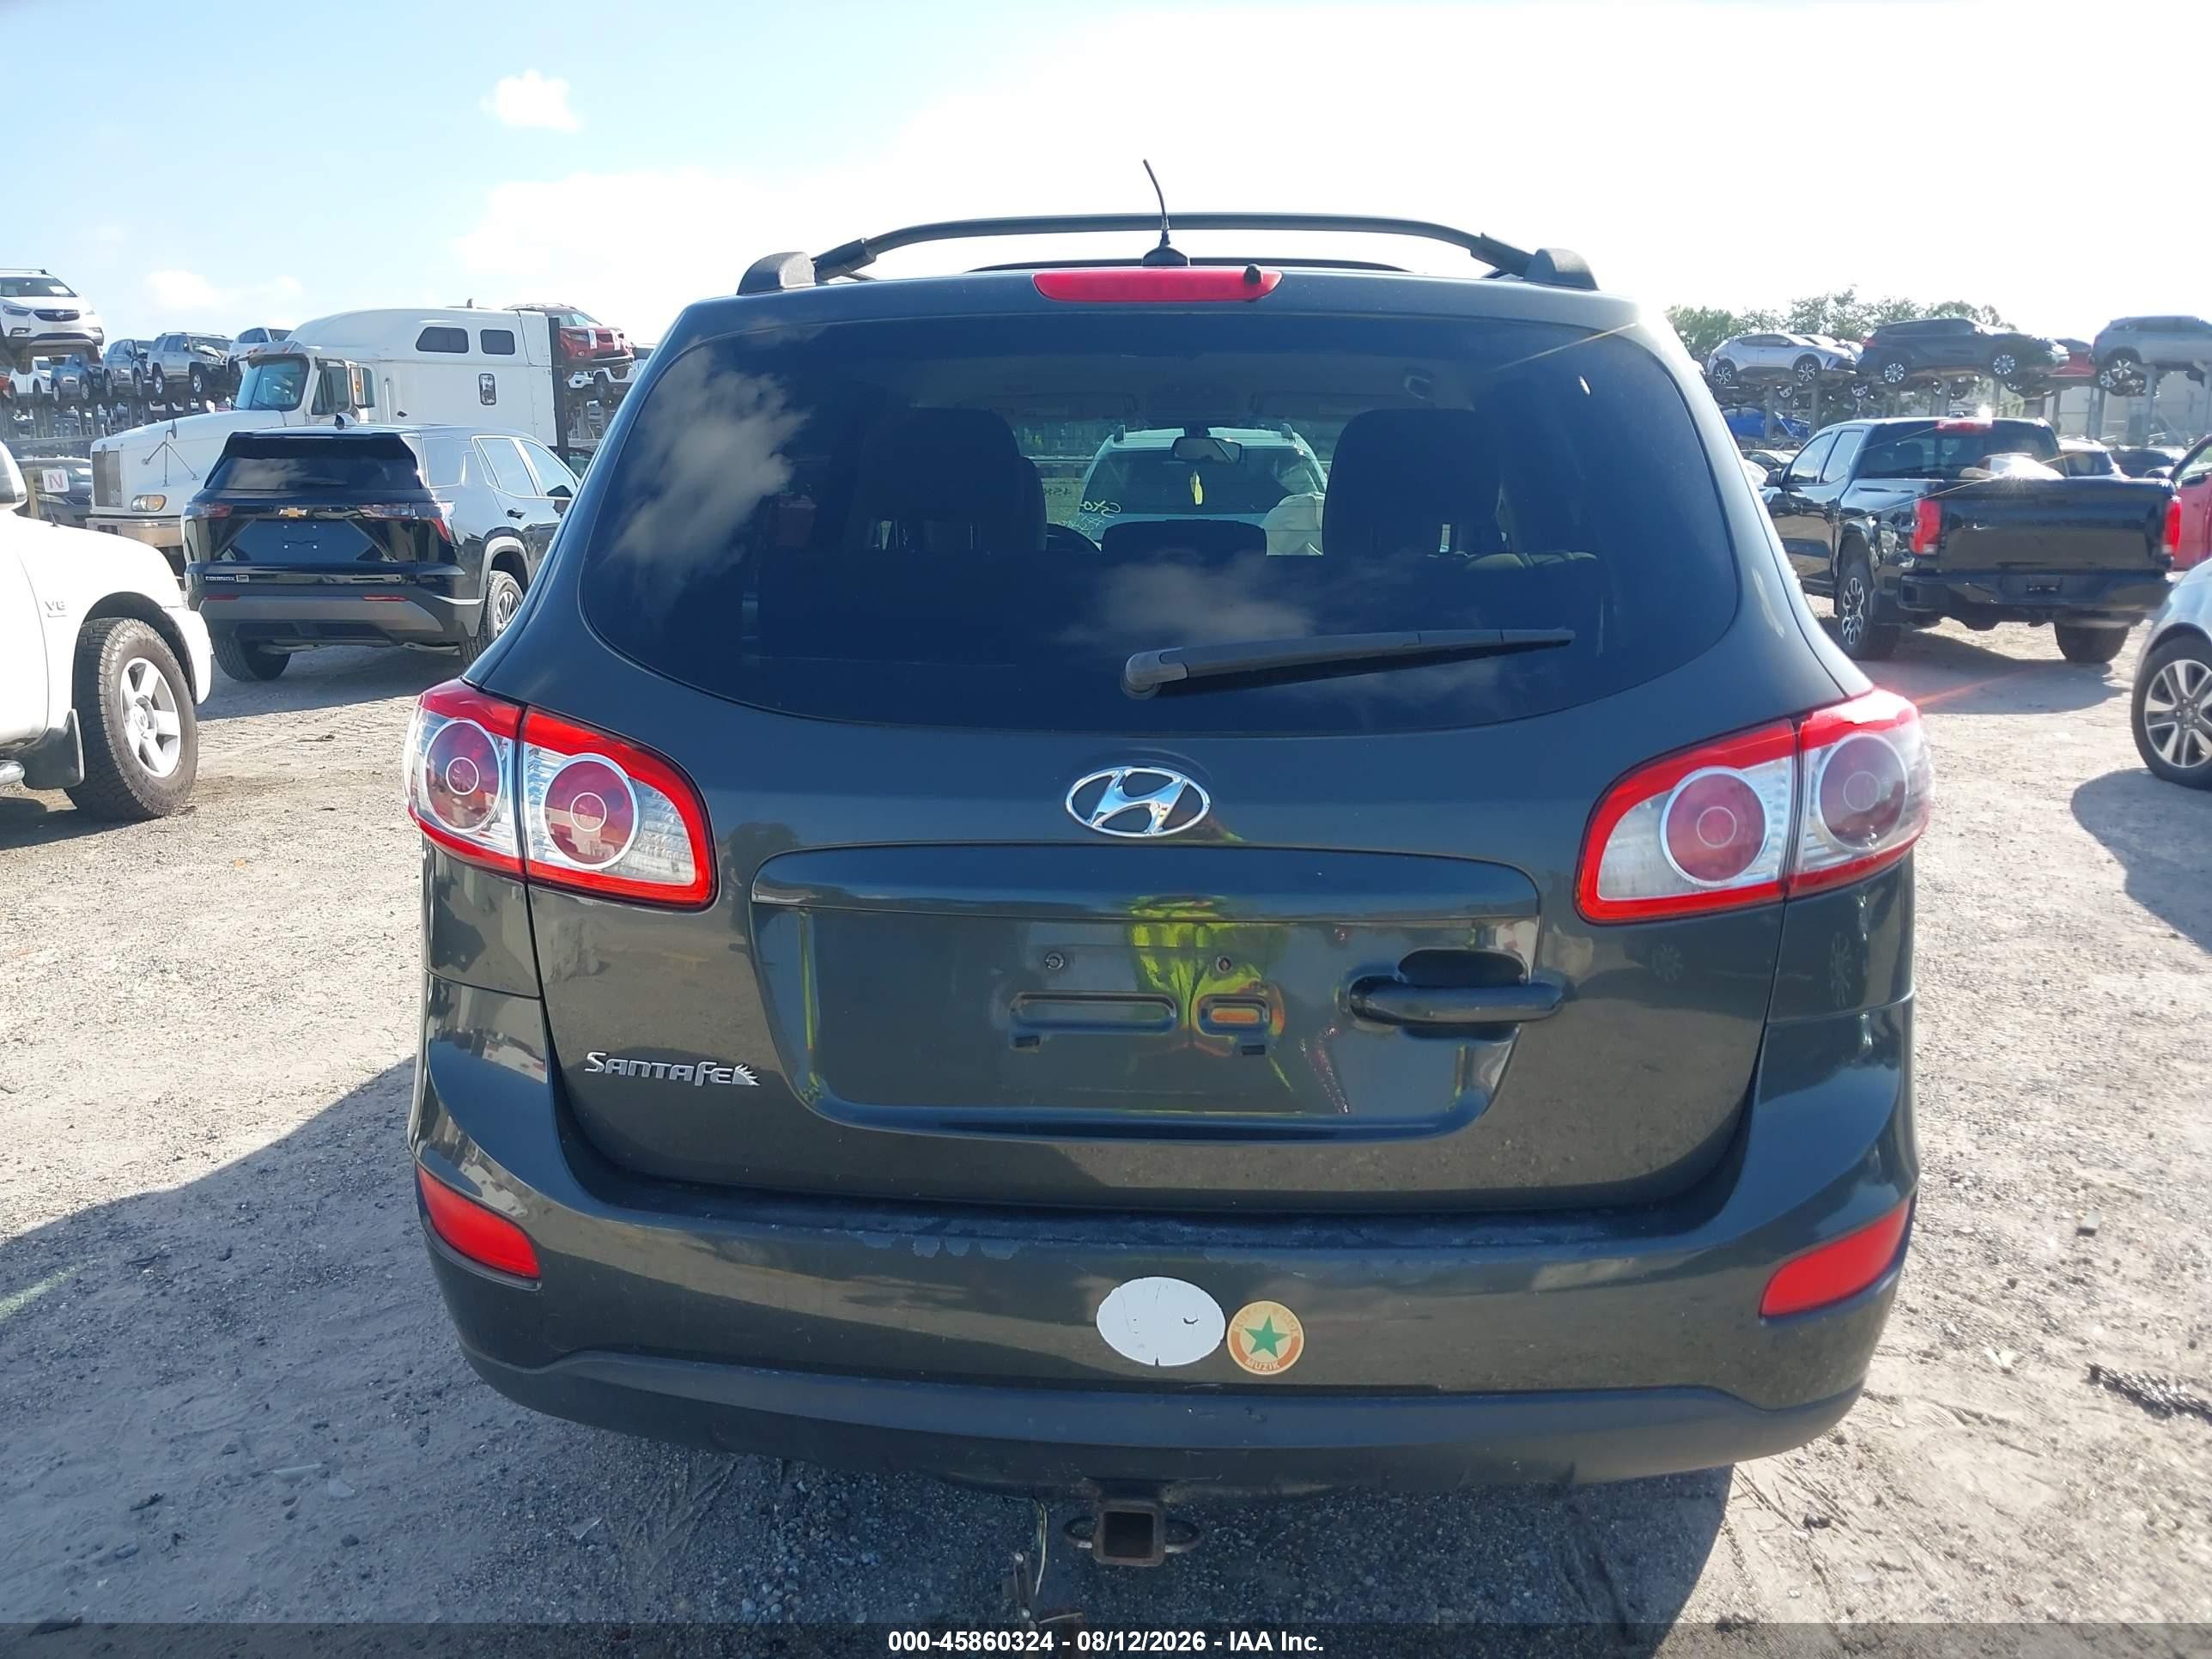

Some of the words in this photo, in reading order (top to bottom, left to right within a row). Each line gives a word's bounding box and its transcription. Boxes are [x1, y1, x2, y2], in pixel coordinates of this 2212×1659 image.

[48, 473, 64, 489] N
[44, 600, 66, 611] V6
[1244, 1358, 1281, 1370] MUZIK
